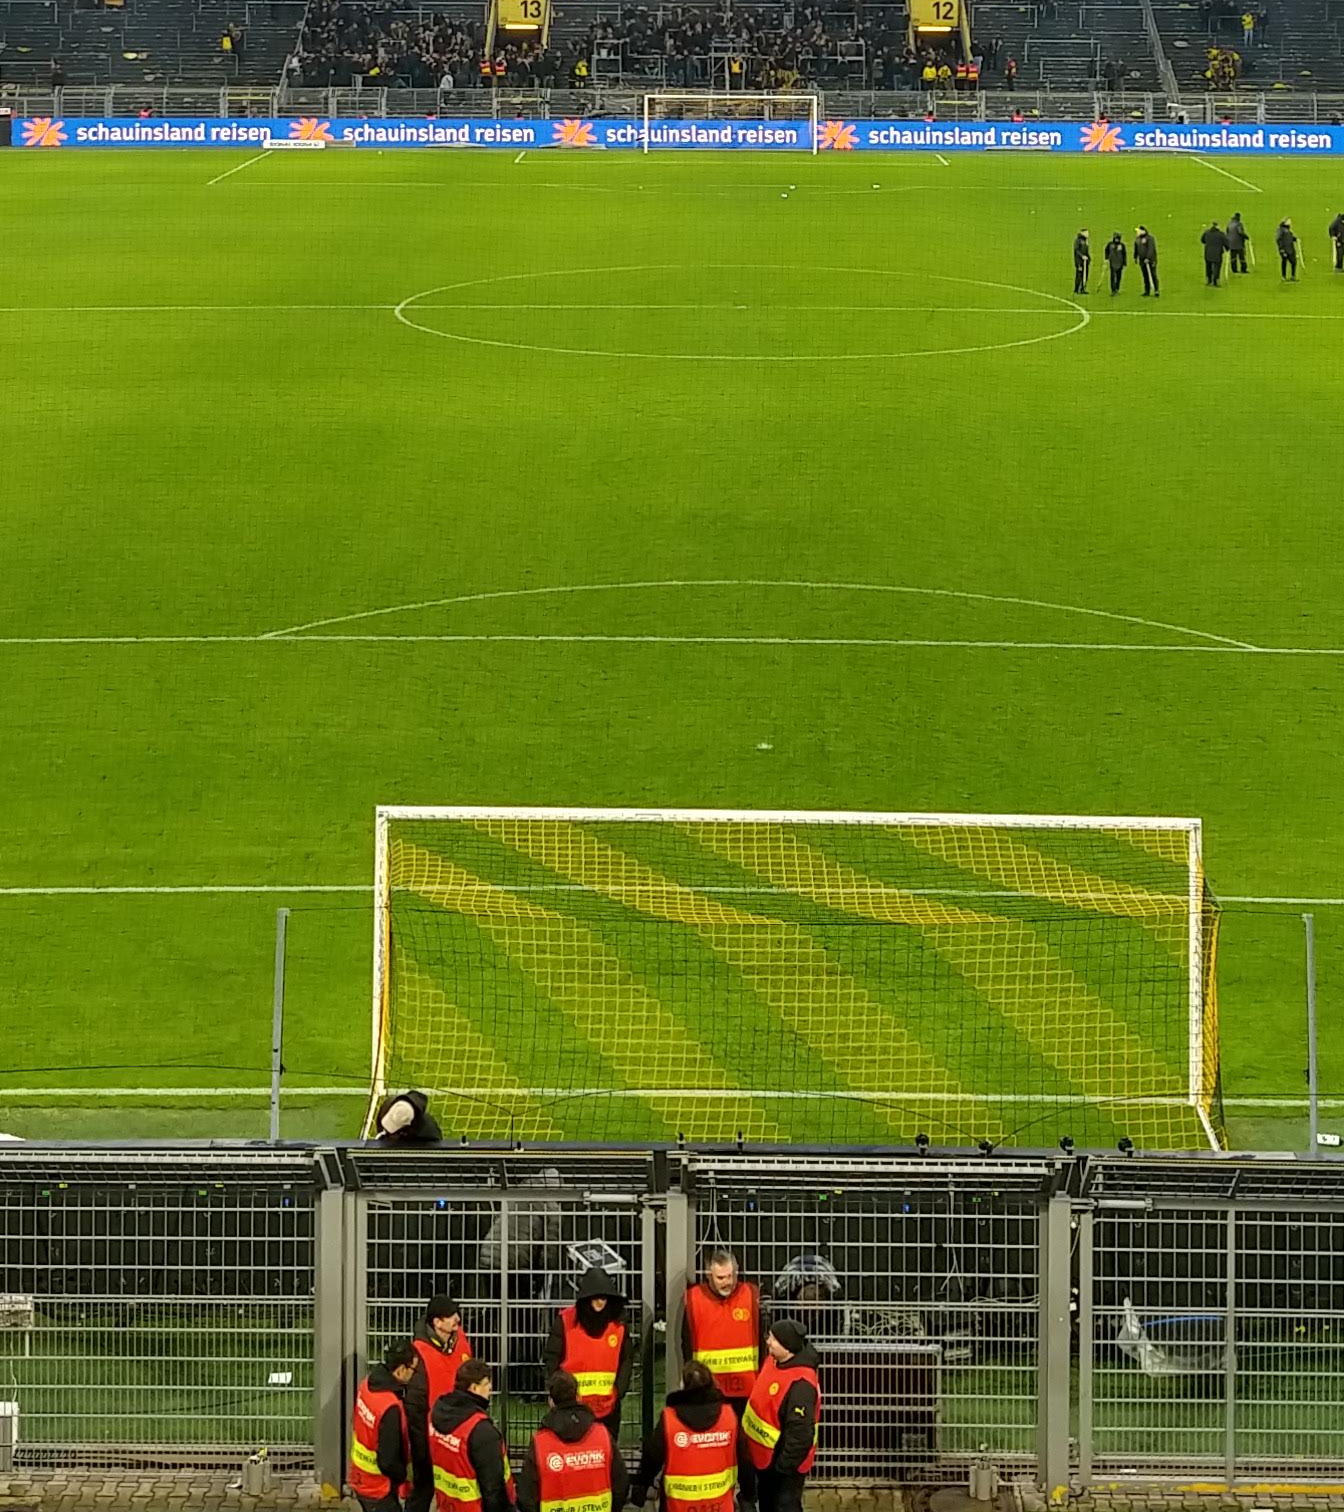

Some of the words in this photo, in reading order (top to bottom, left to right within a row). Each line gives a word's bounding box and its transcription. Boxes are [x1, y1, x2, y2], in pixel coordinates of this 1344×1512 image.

[520, 0, 542, 18] 13
[932, 1, 954, 20] 12
[76, 122, 205, 142] schauinsland
[210, 122, 271, 142] reisen
[343, 123, 469, 143] schauinsland
[475, 124, 535, 143] reisen
[606, 124, 732, 144] schauinsland
[737, 125, 797, 144] reisen
[868, 126, 996, 146] schauinsland
[1002, 127, 1061, 146] reisen
[1134, 128, 1264, 148] schauinsland
[1269, 129, 1332, 148] reisen
